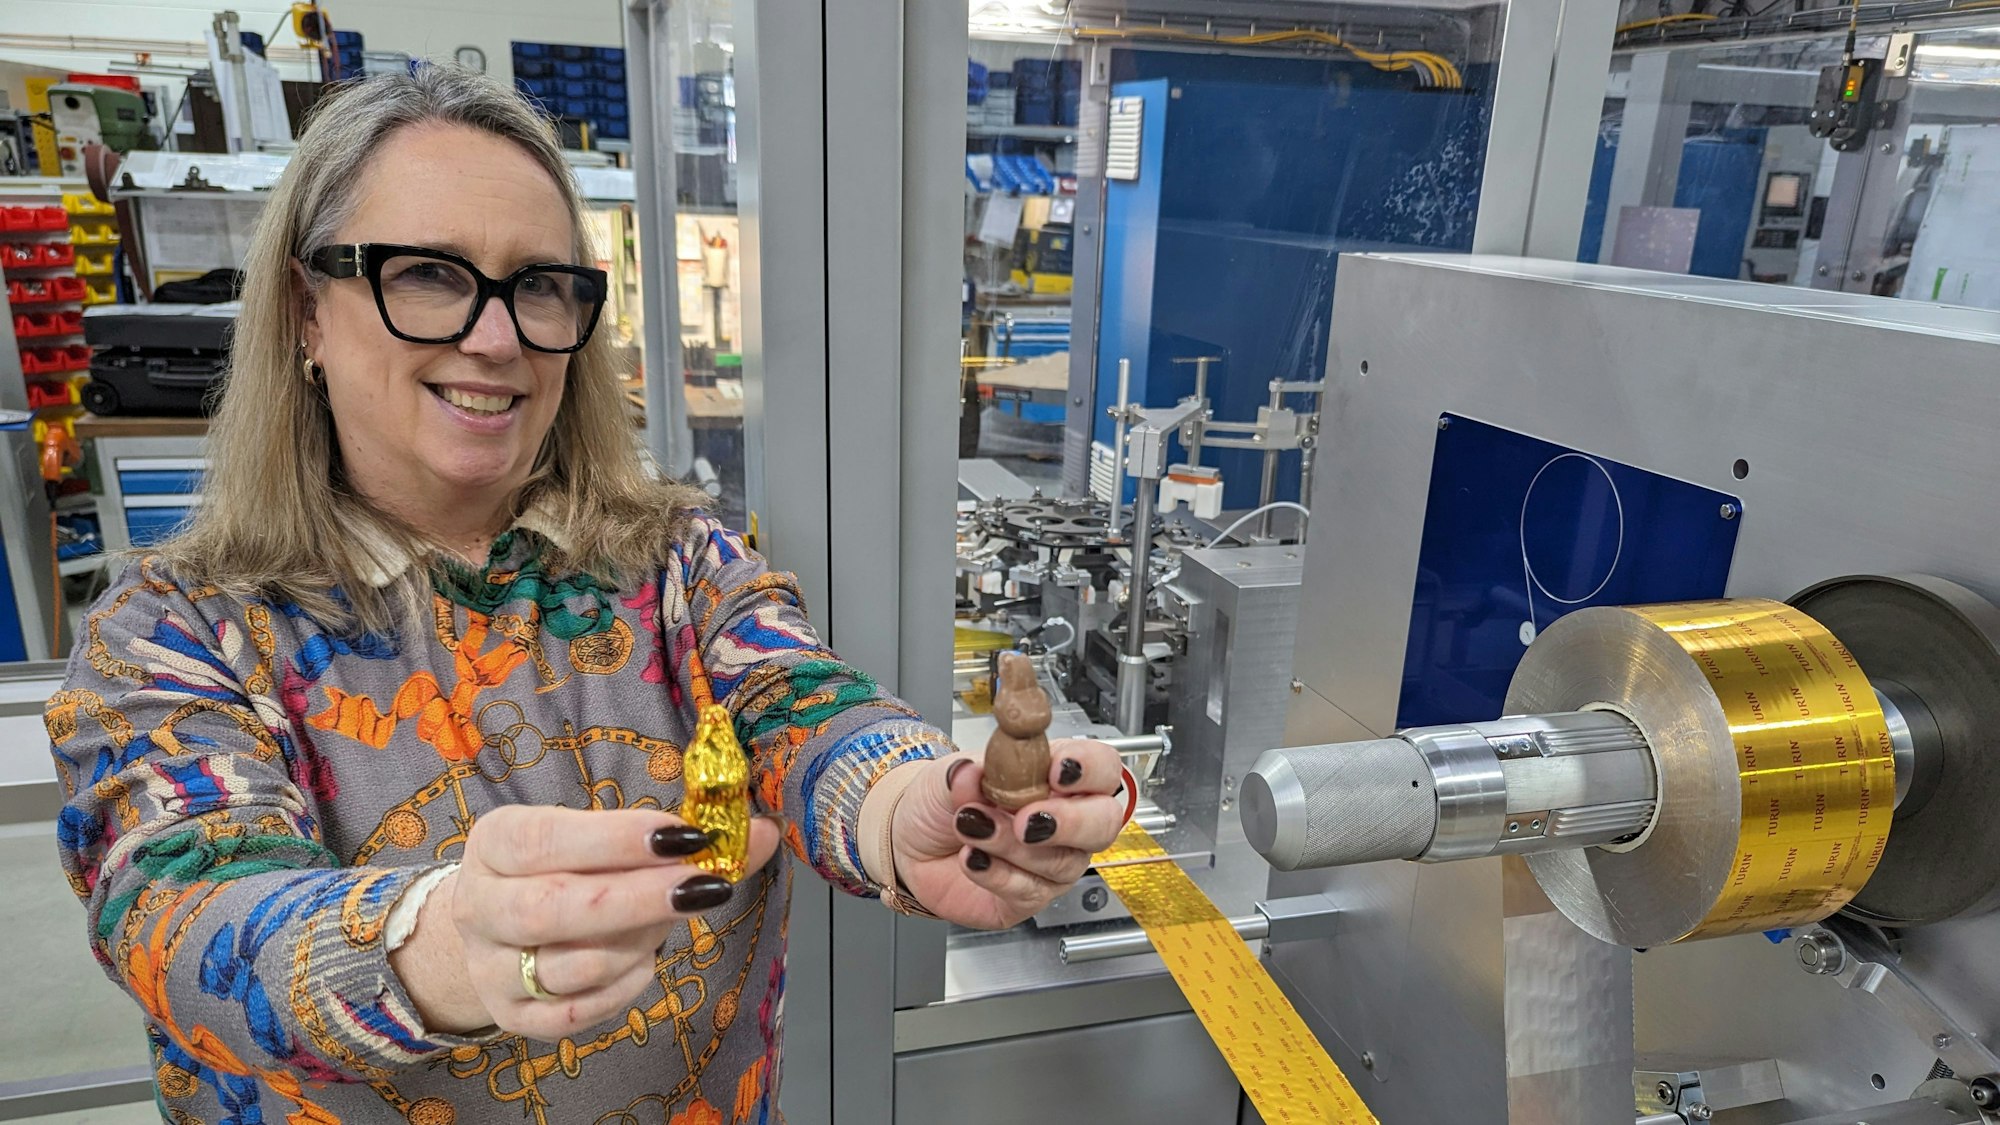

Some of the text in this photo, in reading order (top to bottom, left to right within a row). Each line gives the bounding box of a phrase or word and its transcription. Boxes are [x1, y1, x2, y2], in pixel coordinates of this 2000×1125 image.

[1698, 650, 1724, 680] TURIN
[1743, 646, 1769, 676] TURIN
[1785, 643, 1814, 672] TURIN
[1828, 639, 1857, 669] TURIN
[1745, 691, 1765, 721] URIN
[1790, 687, 1810, 717] URIN
[1878, 731, 1893, 770] TURIN
[1768, 798, 1780, 837] TURIN
[1812, 793, 1825, 832] TURIN
[1858, 788, 1870, 827] TURIN
[1778, 847, 1799, 881] TURIN
[1822, 841, 1842, 876] TURIN
[1865, 835, 1886, 870] TURIN
[1733, 852, 1753, 888] TURIN
